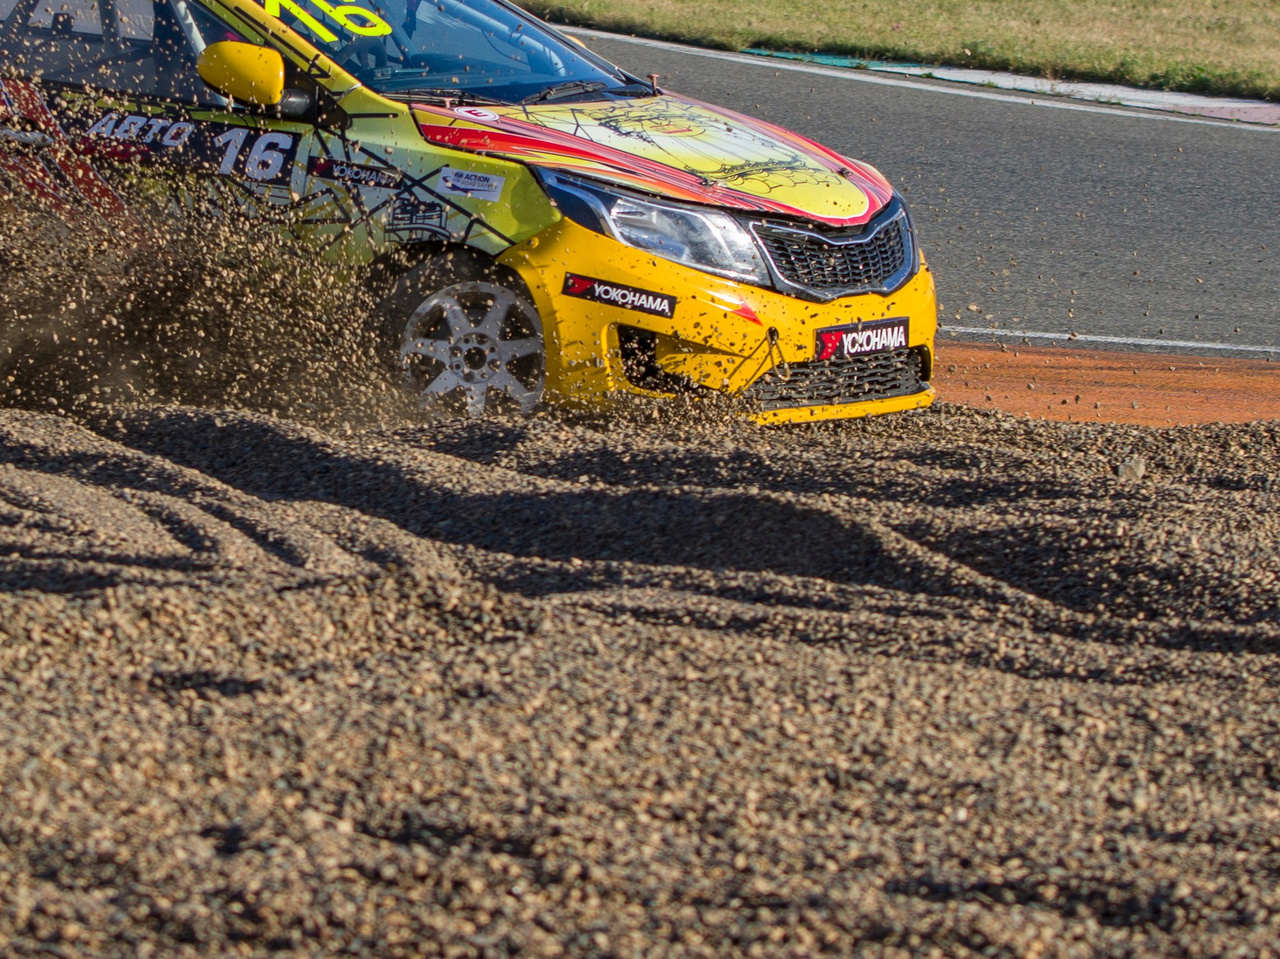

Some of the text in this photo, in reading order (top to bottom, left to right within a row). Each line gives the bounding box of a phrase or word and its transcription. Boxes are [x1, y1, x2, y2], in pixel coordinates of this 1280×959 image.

[85, 112, 196, 147] АВТО
[213, 127, 293, 181] 16
[332, 164, 400, 186] YOKOHAMA
[464, 173, 491, 183] ACTION
[593, 282, 672, 314] YOKOHAMA
[841, 324, 906, 355] YOKOHAMA
